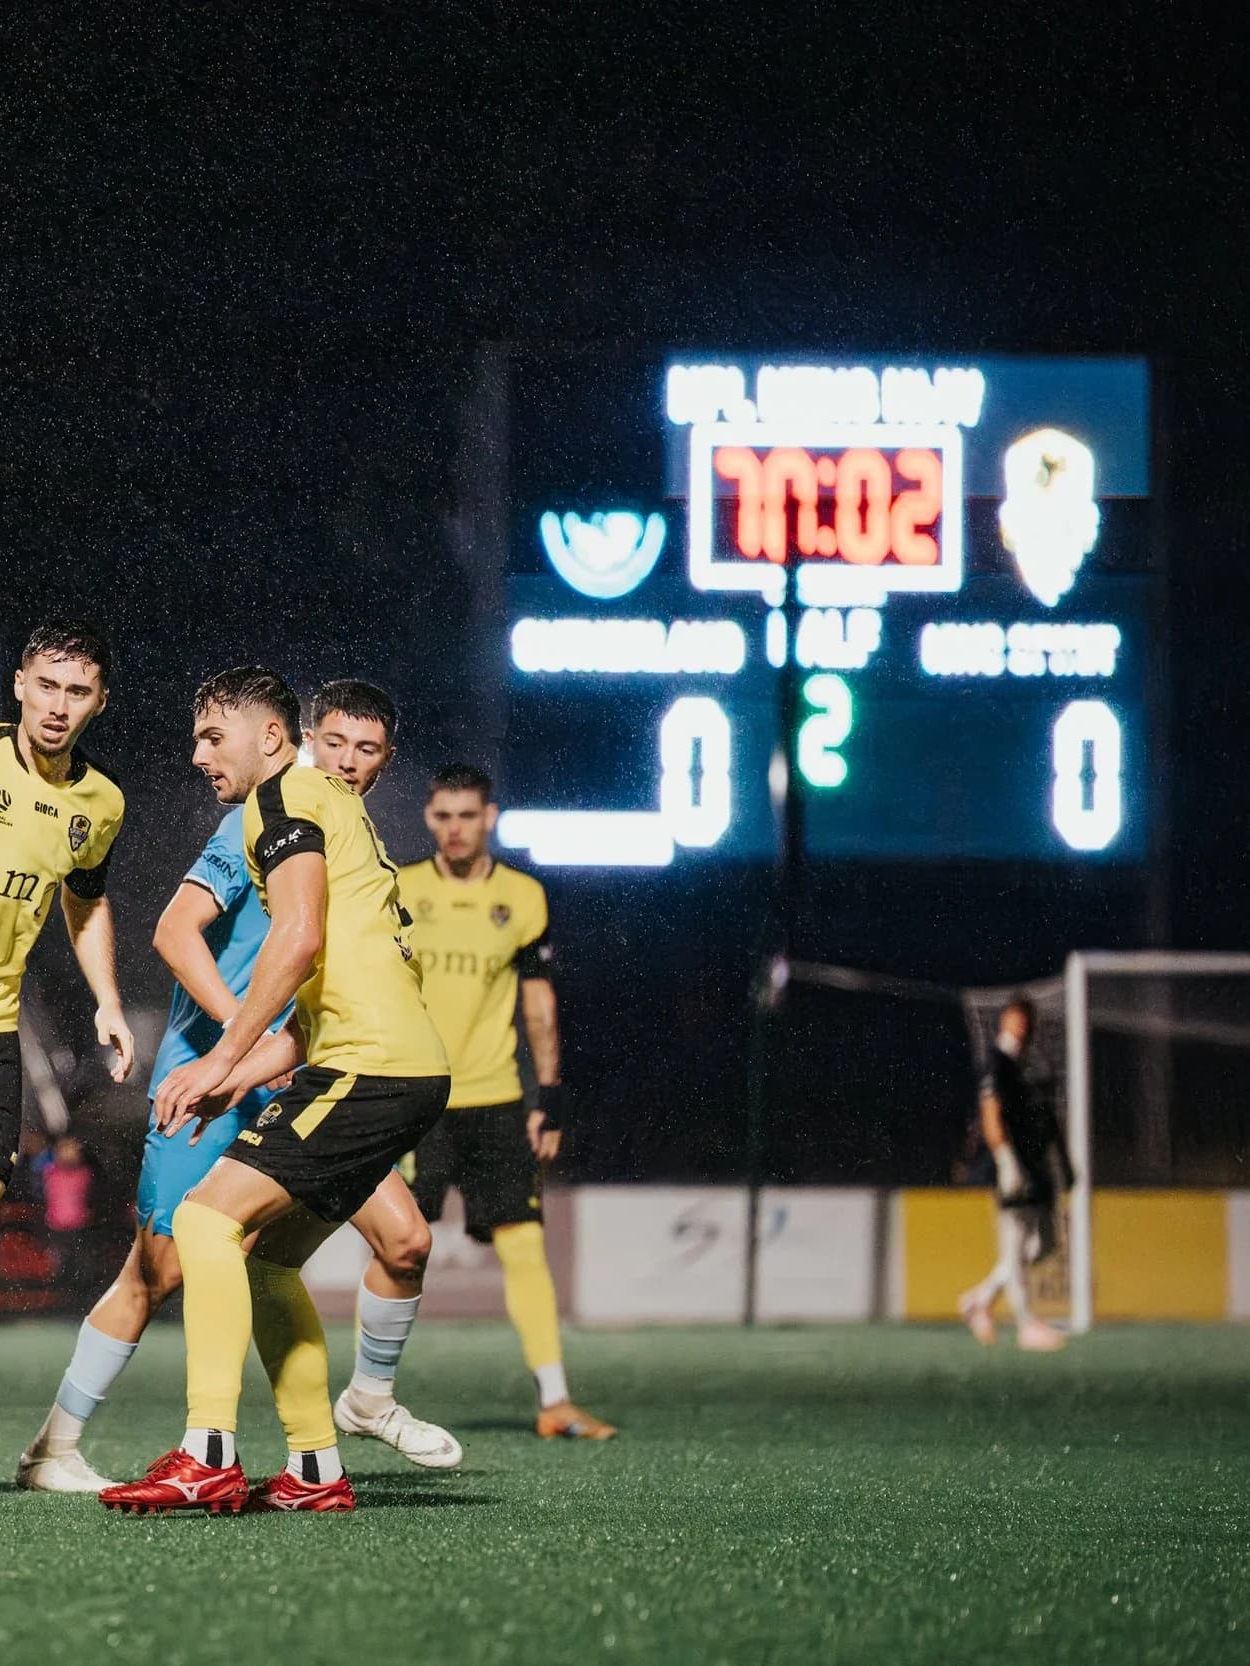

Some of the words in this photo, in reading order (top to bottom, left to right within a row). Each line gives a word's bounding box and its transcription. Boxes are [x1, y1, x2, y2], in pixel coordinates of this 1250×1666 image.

[661, 697, 732, 848] 0
[798, 674, 851, 787] 2
[1053, 700, 1121, 850] 0
[34, 801, 59, 819] GIOCA
